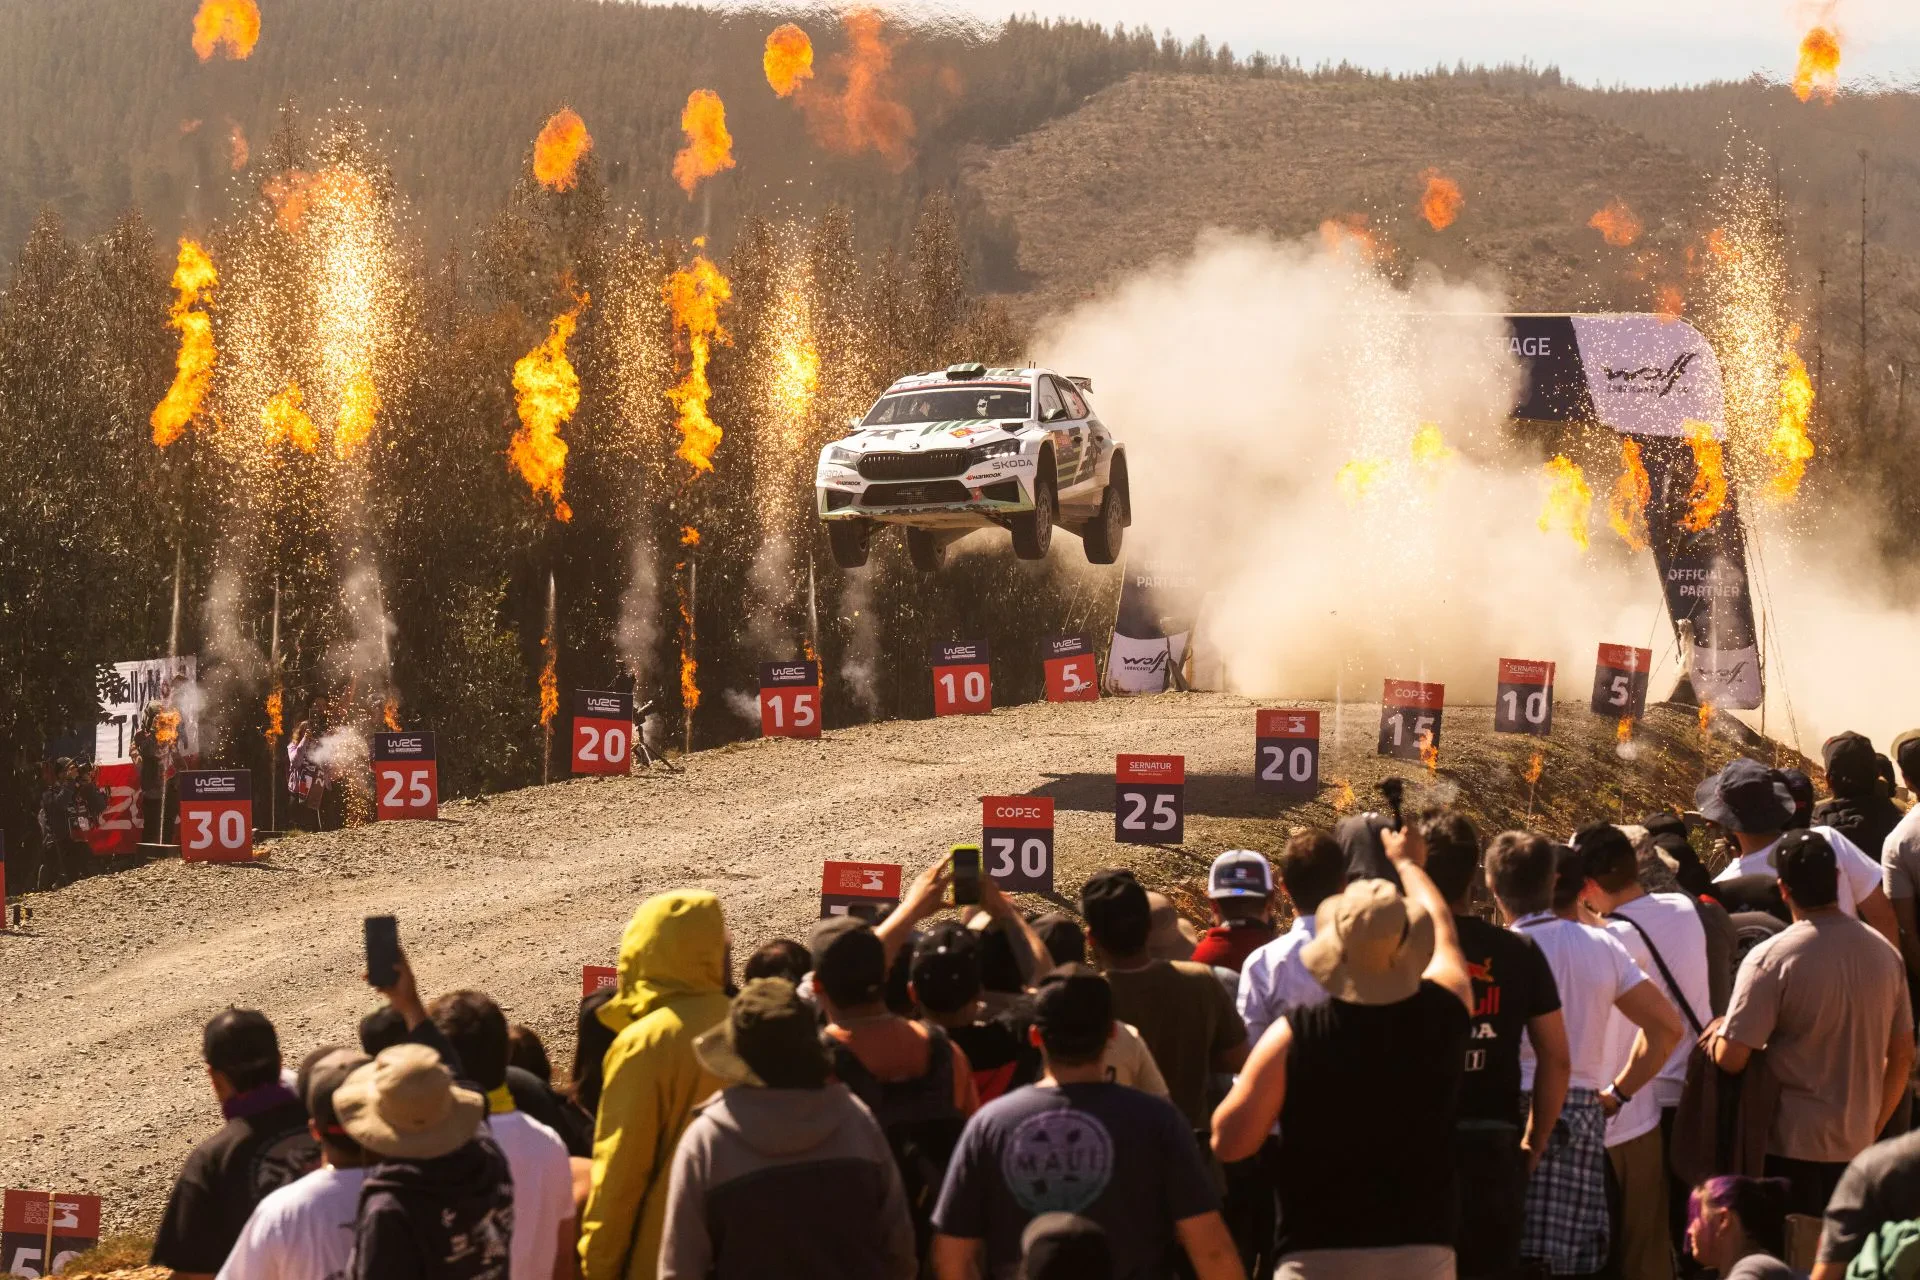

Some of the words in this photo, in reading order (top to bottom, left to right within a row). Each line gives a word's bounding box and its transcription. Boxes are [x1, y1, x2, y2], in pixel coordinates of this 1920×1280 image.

[1680, 584, 1740, 597] PARTNER
[943, 646, 976, 655] WRC
[1052, 638, 1082, 649] WRC
[772, 667, 805, 676] WRC
[1062, 663, 1081, 693] 5
[587, 697, 621, 708] WRC
[939, 671, 985, 704] 10
[1395, 688, 1433, 701] COPEC
[1608, 675, 1629, 707] 5
[767, 694, 815, 728] 15
[1502, 690, 1547, 724] 10
[387, 738, 422, 748] WRC
[578, 726, 626, 763] 20
[1387, 713, 1435, 749] 15
[1129, 761, 1172, 770] SERNATUR
[1261, 746, 1312, 782] 20
[195, 777, 236, 787] WRC
[381, 770, 432, 807] 25
[996, 806, 1041, 819] COPEC
[1122, 792, 1177, 831] 25
[188, 809, 246, 850] 30
[989, 838, 1047, 879] 30
[1016, 1150, 1098, 1173] MAUI
